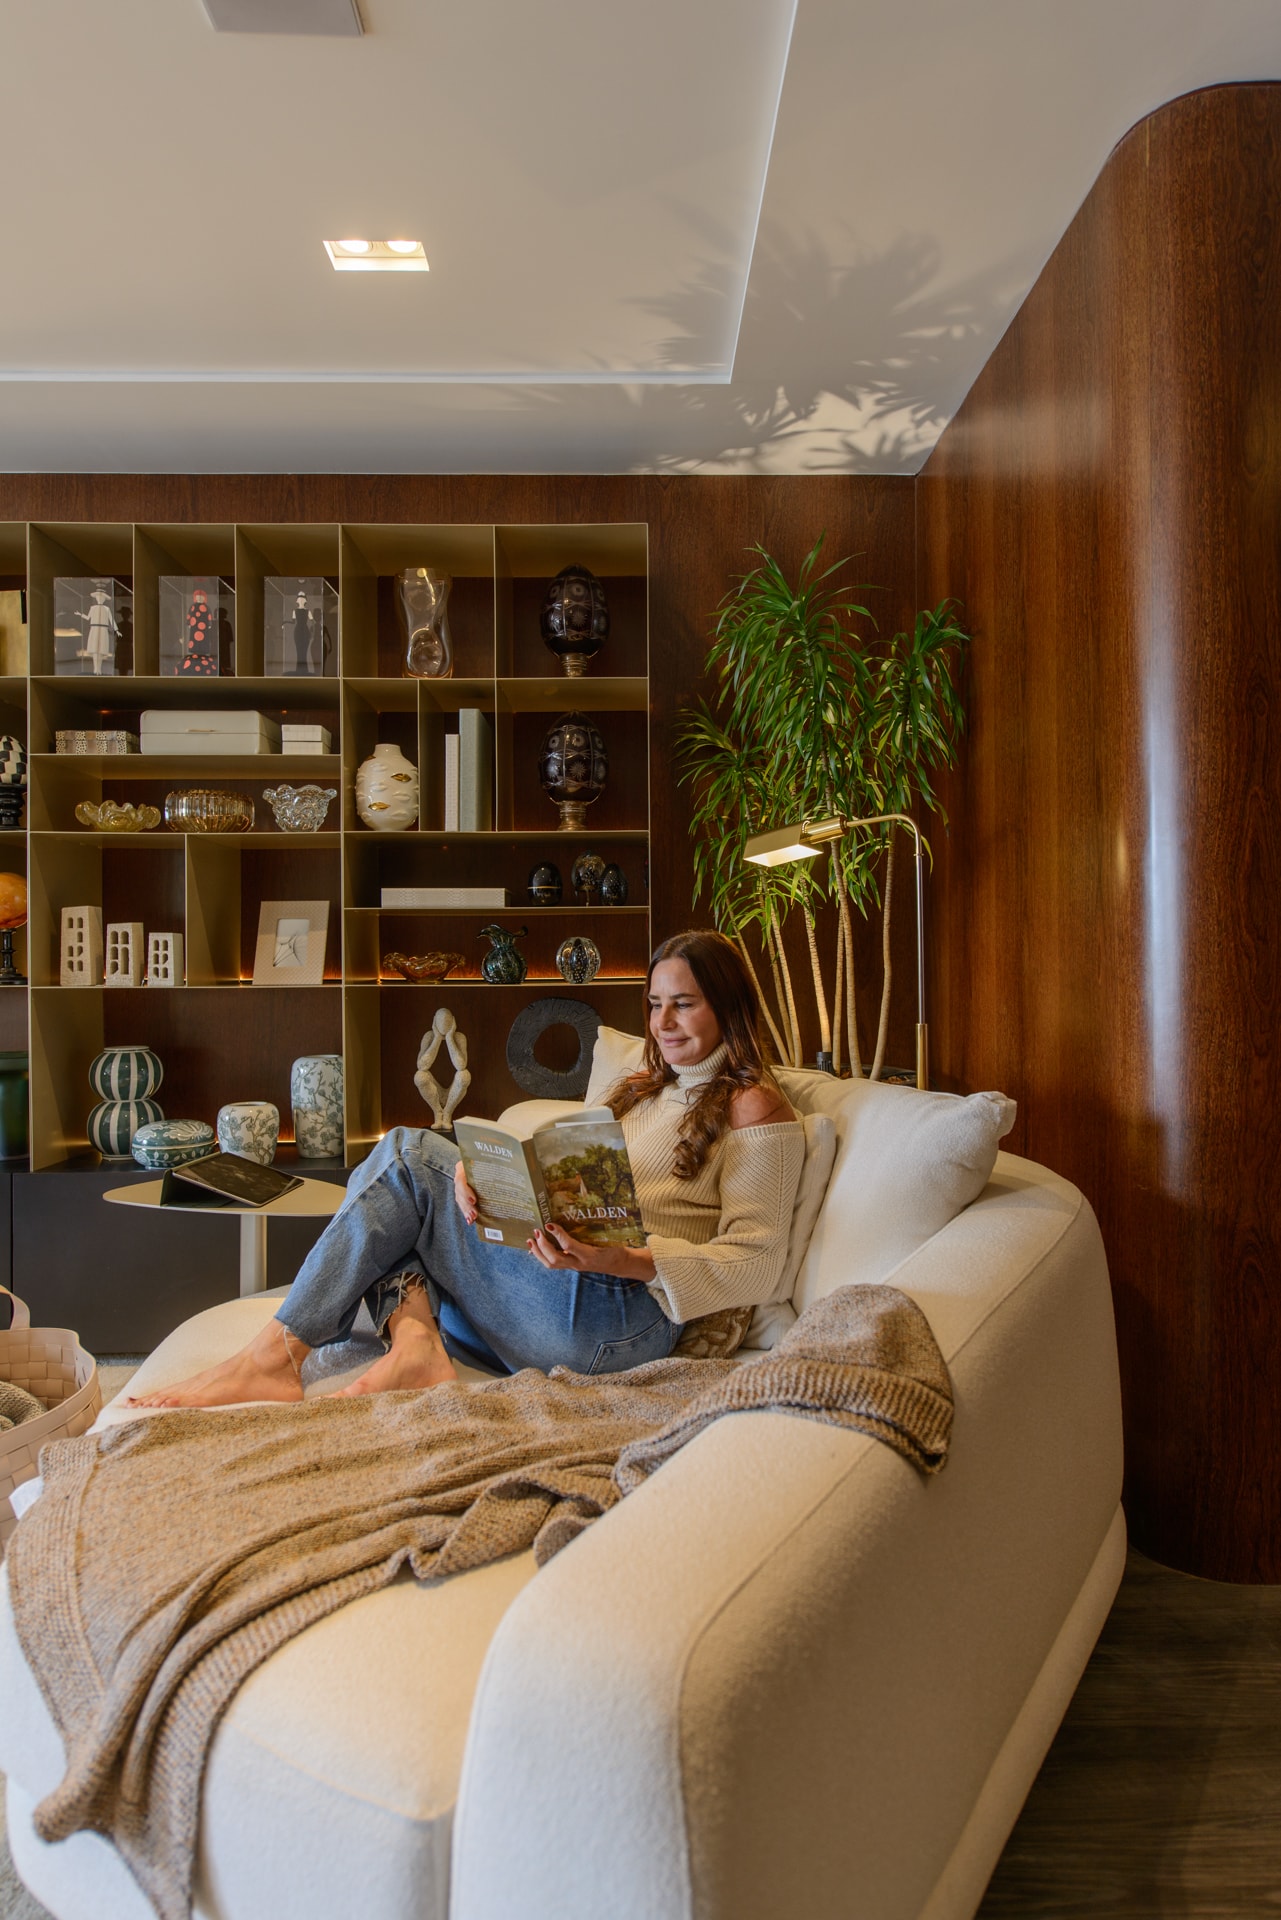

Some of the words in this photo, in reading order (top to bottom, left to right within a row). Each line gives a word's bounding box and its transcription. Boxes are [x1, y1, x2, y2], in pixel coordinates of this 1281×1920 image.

[474, 1141, 513, 1158] WALDEN
[538, 1191, 551, 1224] WALDEN
[562, 1206, 628, 1221] WALDEN
